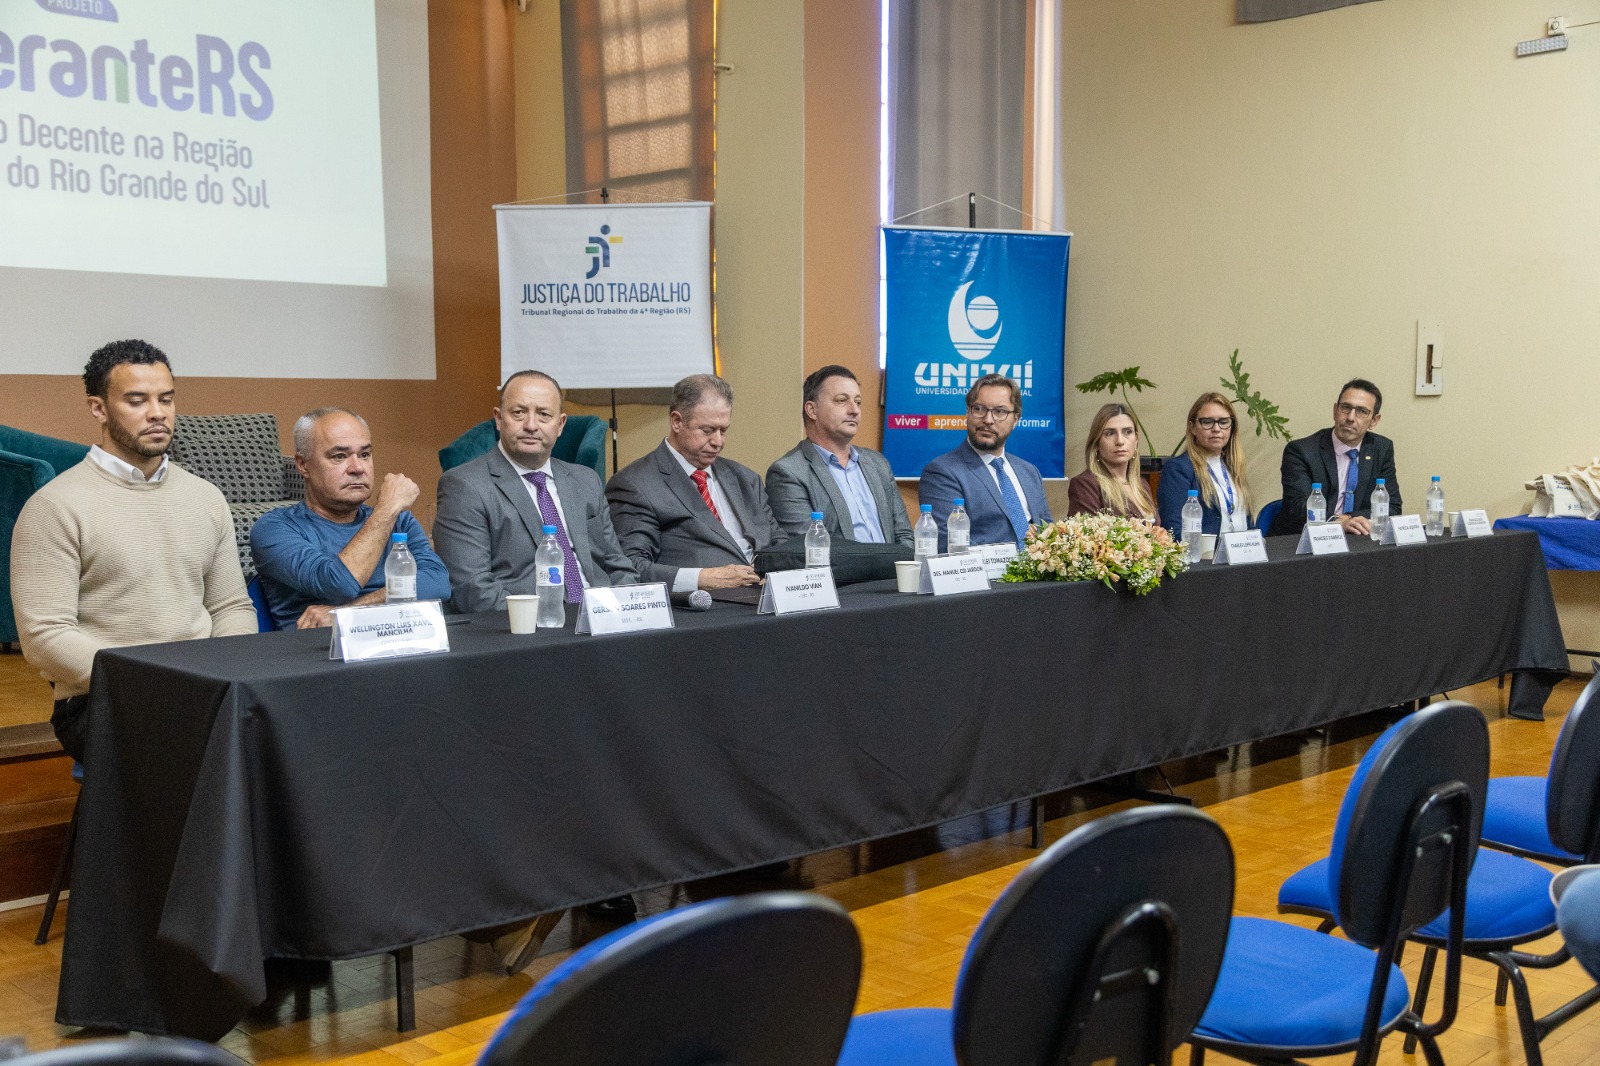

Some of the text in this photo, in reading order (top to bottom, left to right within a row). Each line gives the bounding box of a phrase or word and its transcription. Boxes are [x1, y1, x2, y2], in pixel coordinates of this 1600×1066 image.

[18, 113, 125, 156] Decente
[134, 134, 164, 160] na
[172, 131, 253, 172] Região
[7, 155, 270, 209] do Rio Grande do Sul
[521, 282, 691, 306] JUSTIÇA DO TRABALHO
[521, 308, 551, 316] Tribunal
[552, 308, 584, 317] Regional
[596, 307, 628, 315] Trabalho
[649, 307, 675, 316] Região
[675, 307, 691, 315] (RS)
[915, 387, 970, 396] UNIVERSIDAD
[895, 415, 921, 426] viver
[1017, 416, 1051, 428] formar
[621, 603, 646, 611] SOARES
[350, 624, 396, 634] WELLINGTON
[377, 628, 413, 637] MANCILHA
